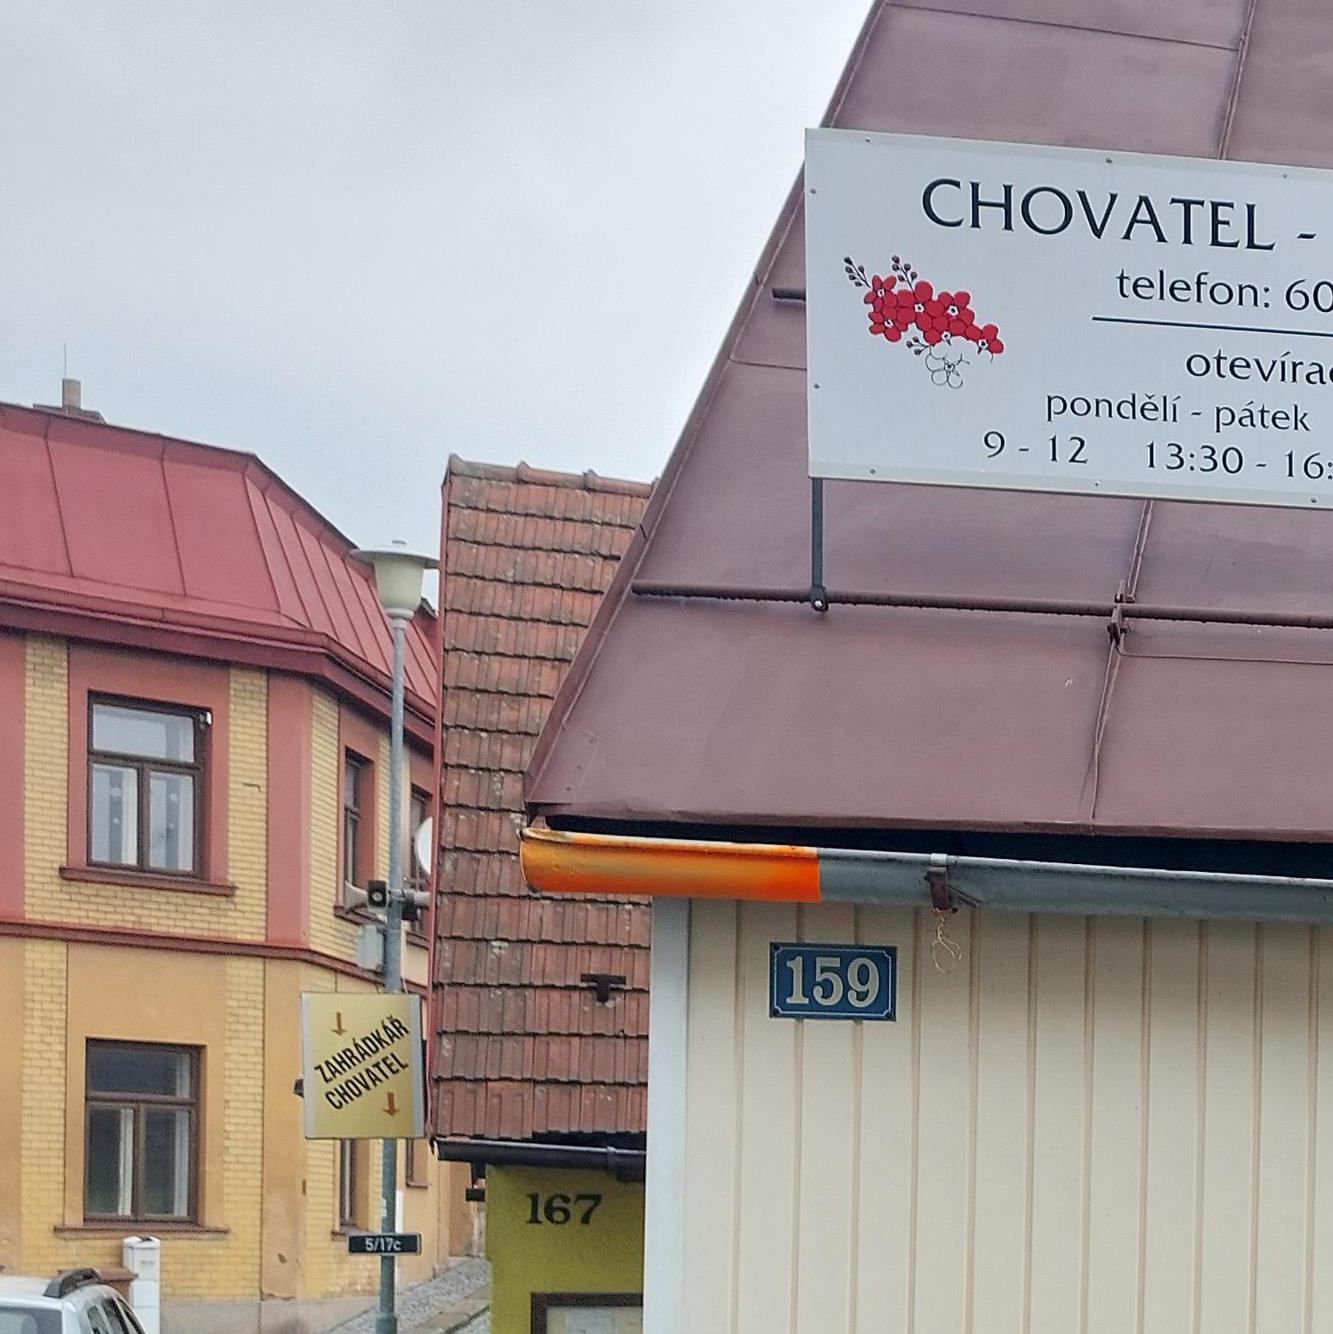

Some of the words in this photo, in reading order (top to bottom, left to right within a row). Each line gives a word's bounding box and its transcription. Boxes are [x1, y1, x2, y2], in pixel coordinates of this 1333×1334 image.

[921, 177, 1276, 253] CHOVATEL
[1115, 268, 1271, 310] telefon:
[1046, 391, 1182, 424] pondělí
[1214, 400, 1312, 435] pátek
[983, 430, 1006, 459] 9
[1049, 434, 1089, 464] 12
[1146, 440, 1244, 476] 13:30
[785, 956, 880, 1010] 159
[313, 1014, 410, 1084] ZAHRÁDKÁŘ
[324, 1051, 410, 1111] CHOVATEL
[525, 1192, 603, 1226] 167
